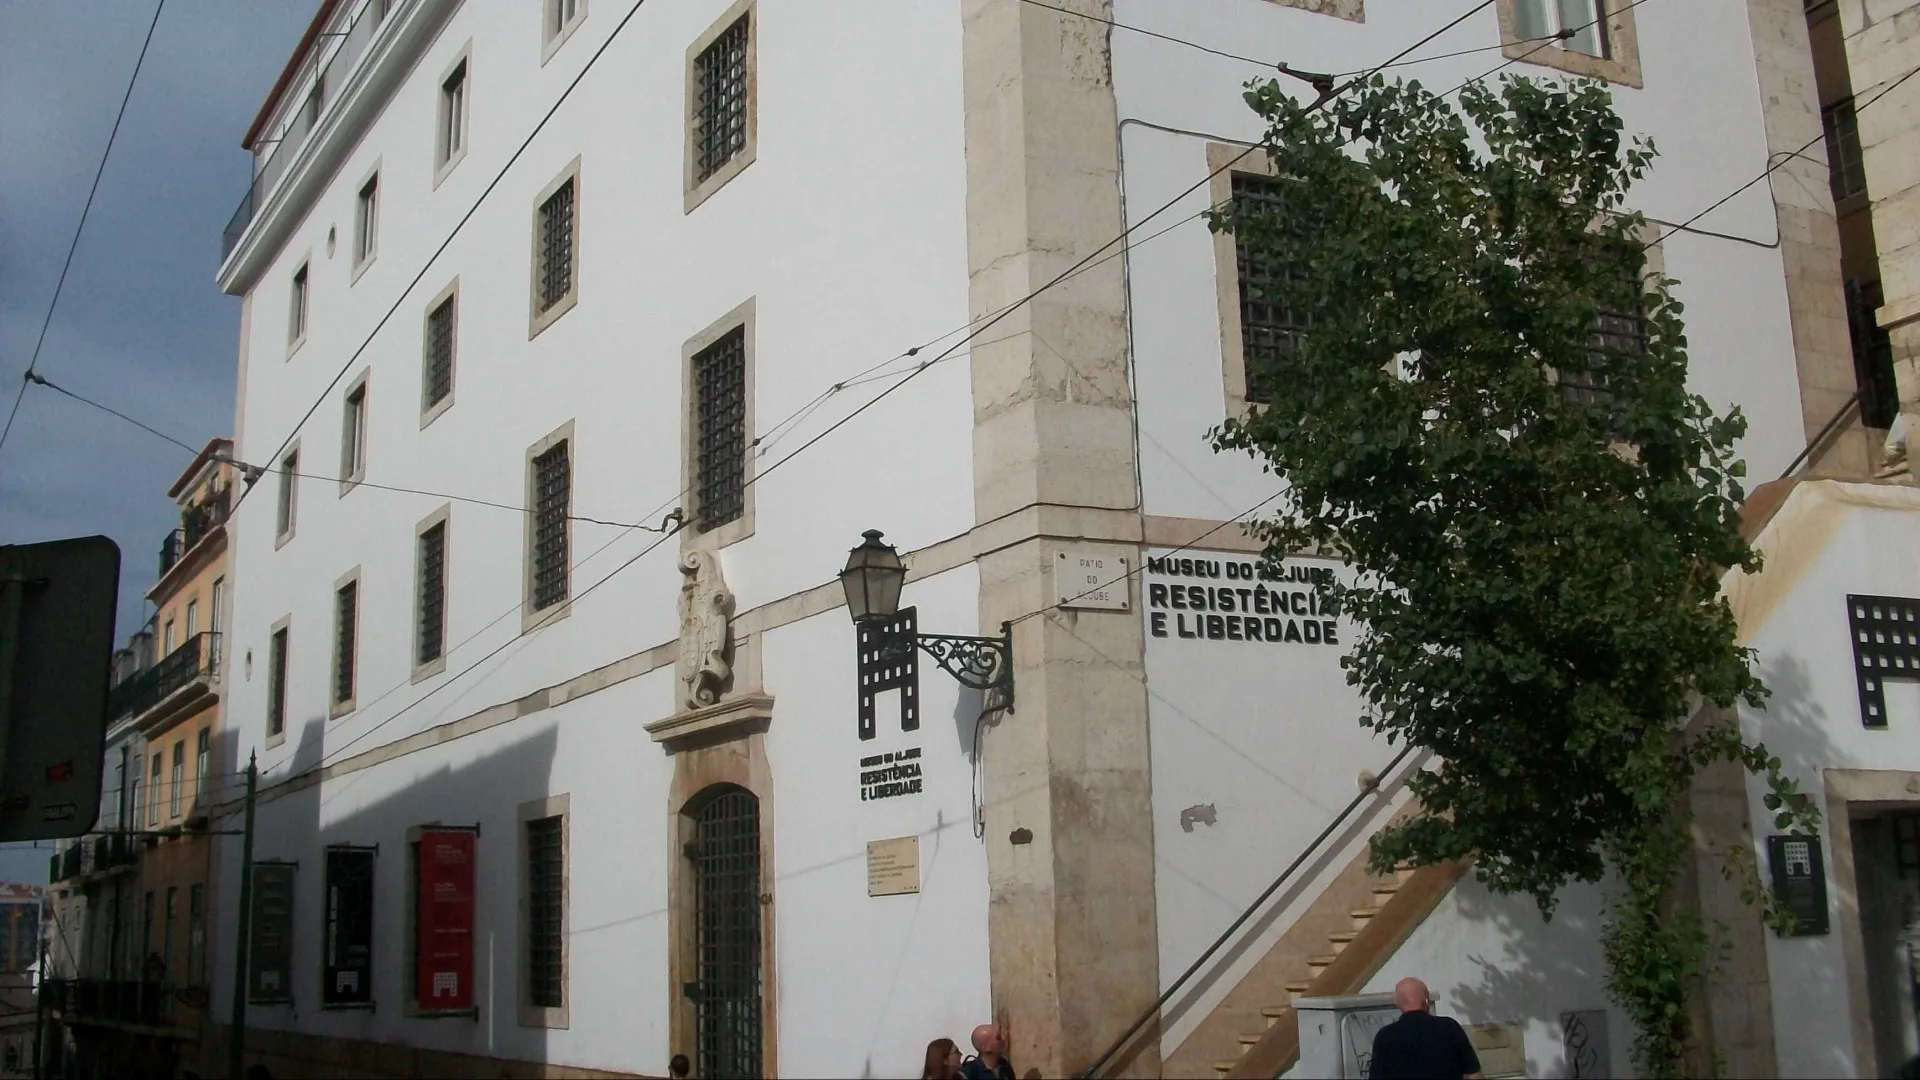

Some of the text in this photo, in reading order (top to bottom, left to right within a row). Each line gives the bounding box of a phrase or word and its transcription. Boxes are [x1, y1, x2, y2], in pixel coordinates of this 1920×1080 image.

[1148, 556, 1221, 579] MUSEU
[1226, 562, 1253, 581] DO
[1150, 611, 1340, 646] E LIBERDADE
[860, 763, 922, 786] RESISTÊNCIA
[861, 778, 923, 801] E LIBERDADE
